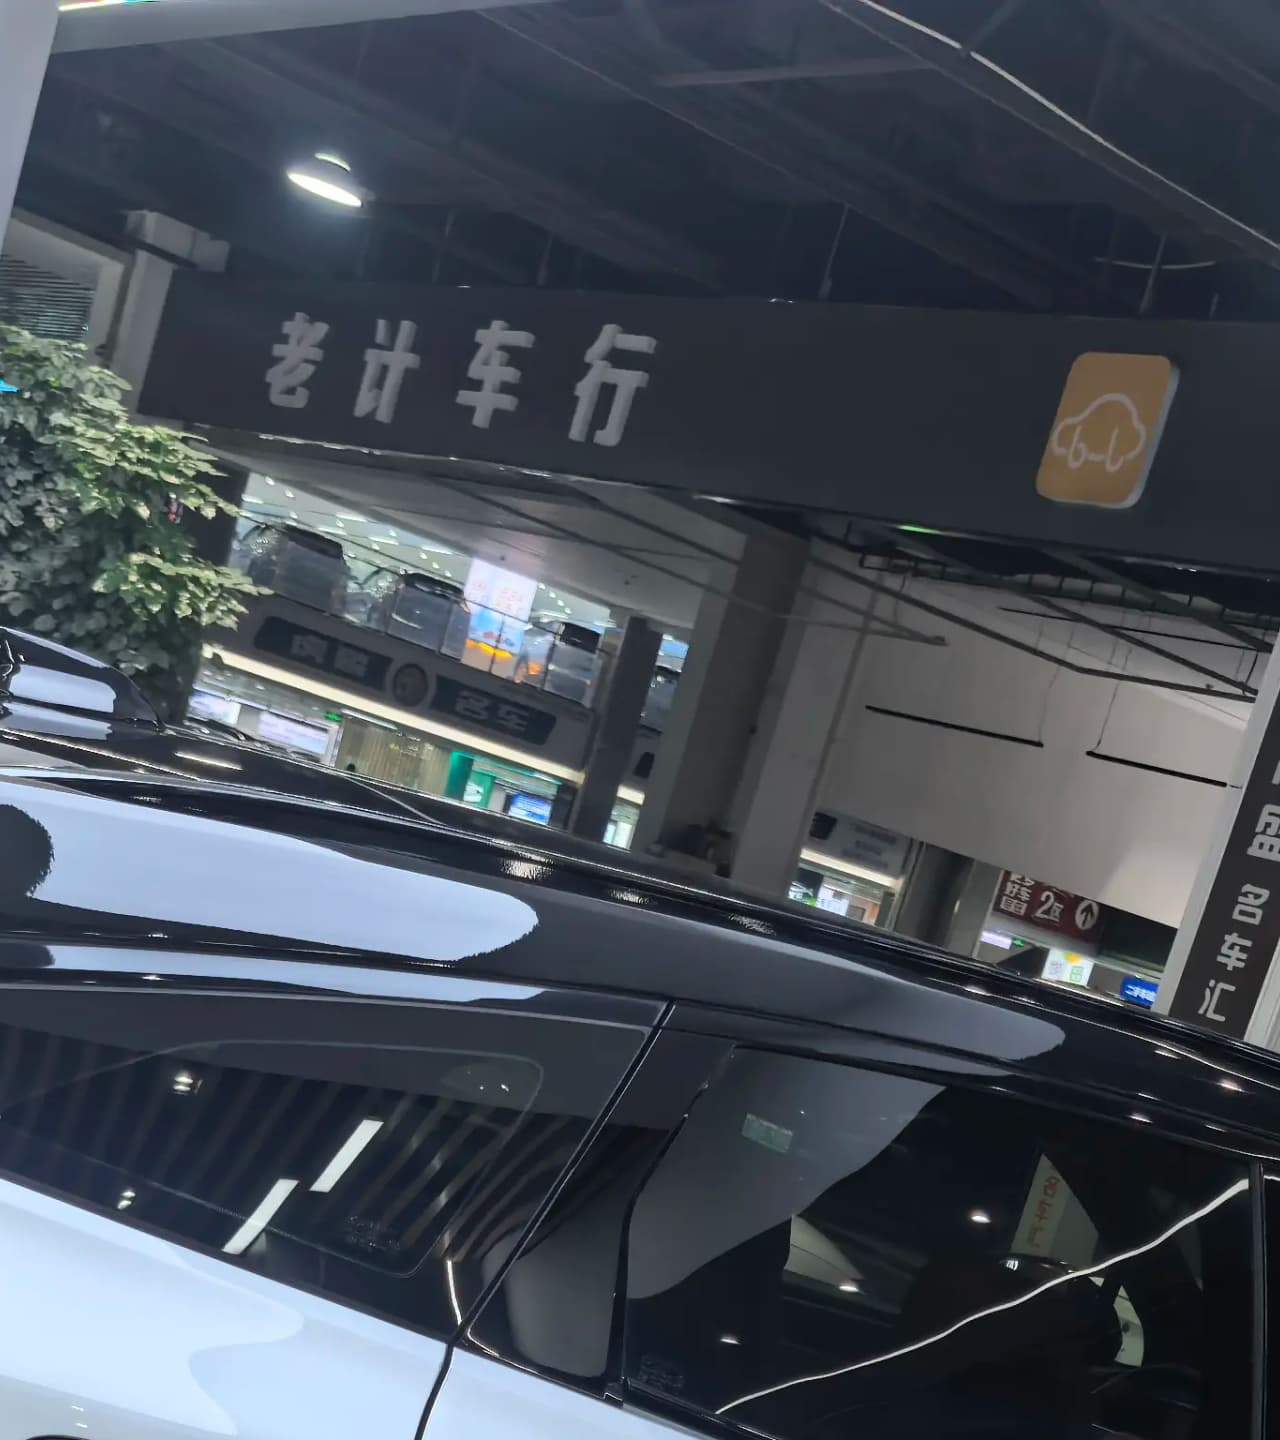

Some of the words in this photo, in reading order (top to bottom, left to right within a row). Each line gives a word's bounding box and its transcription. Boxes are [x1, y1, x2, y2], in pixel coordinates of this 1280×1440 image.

[265, 311, 657, 447] 老计车行
[1031, 890, 1065, 923] 2区
